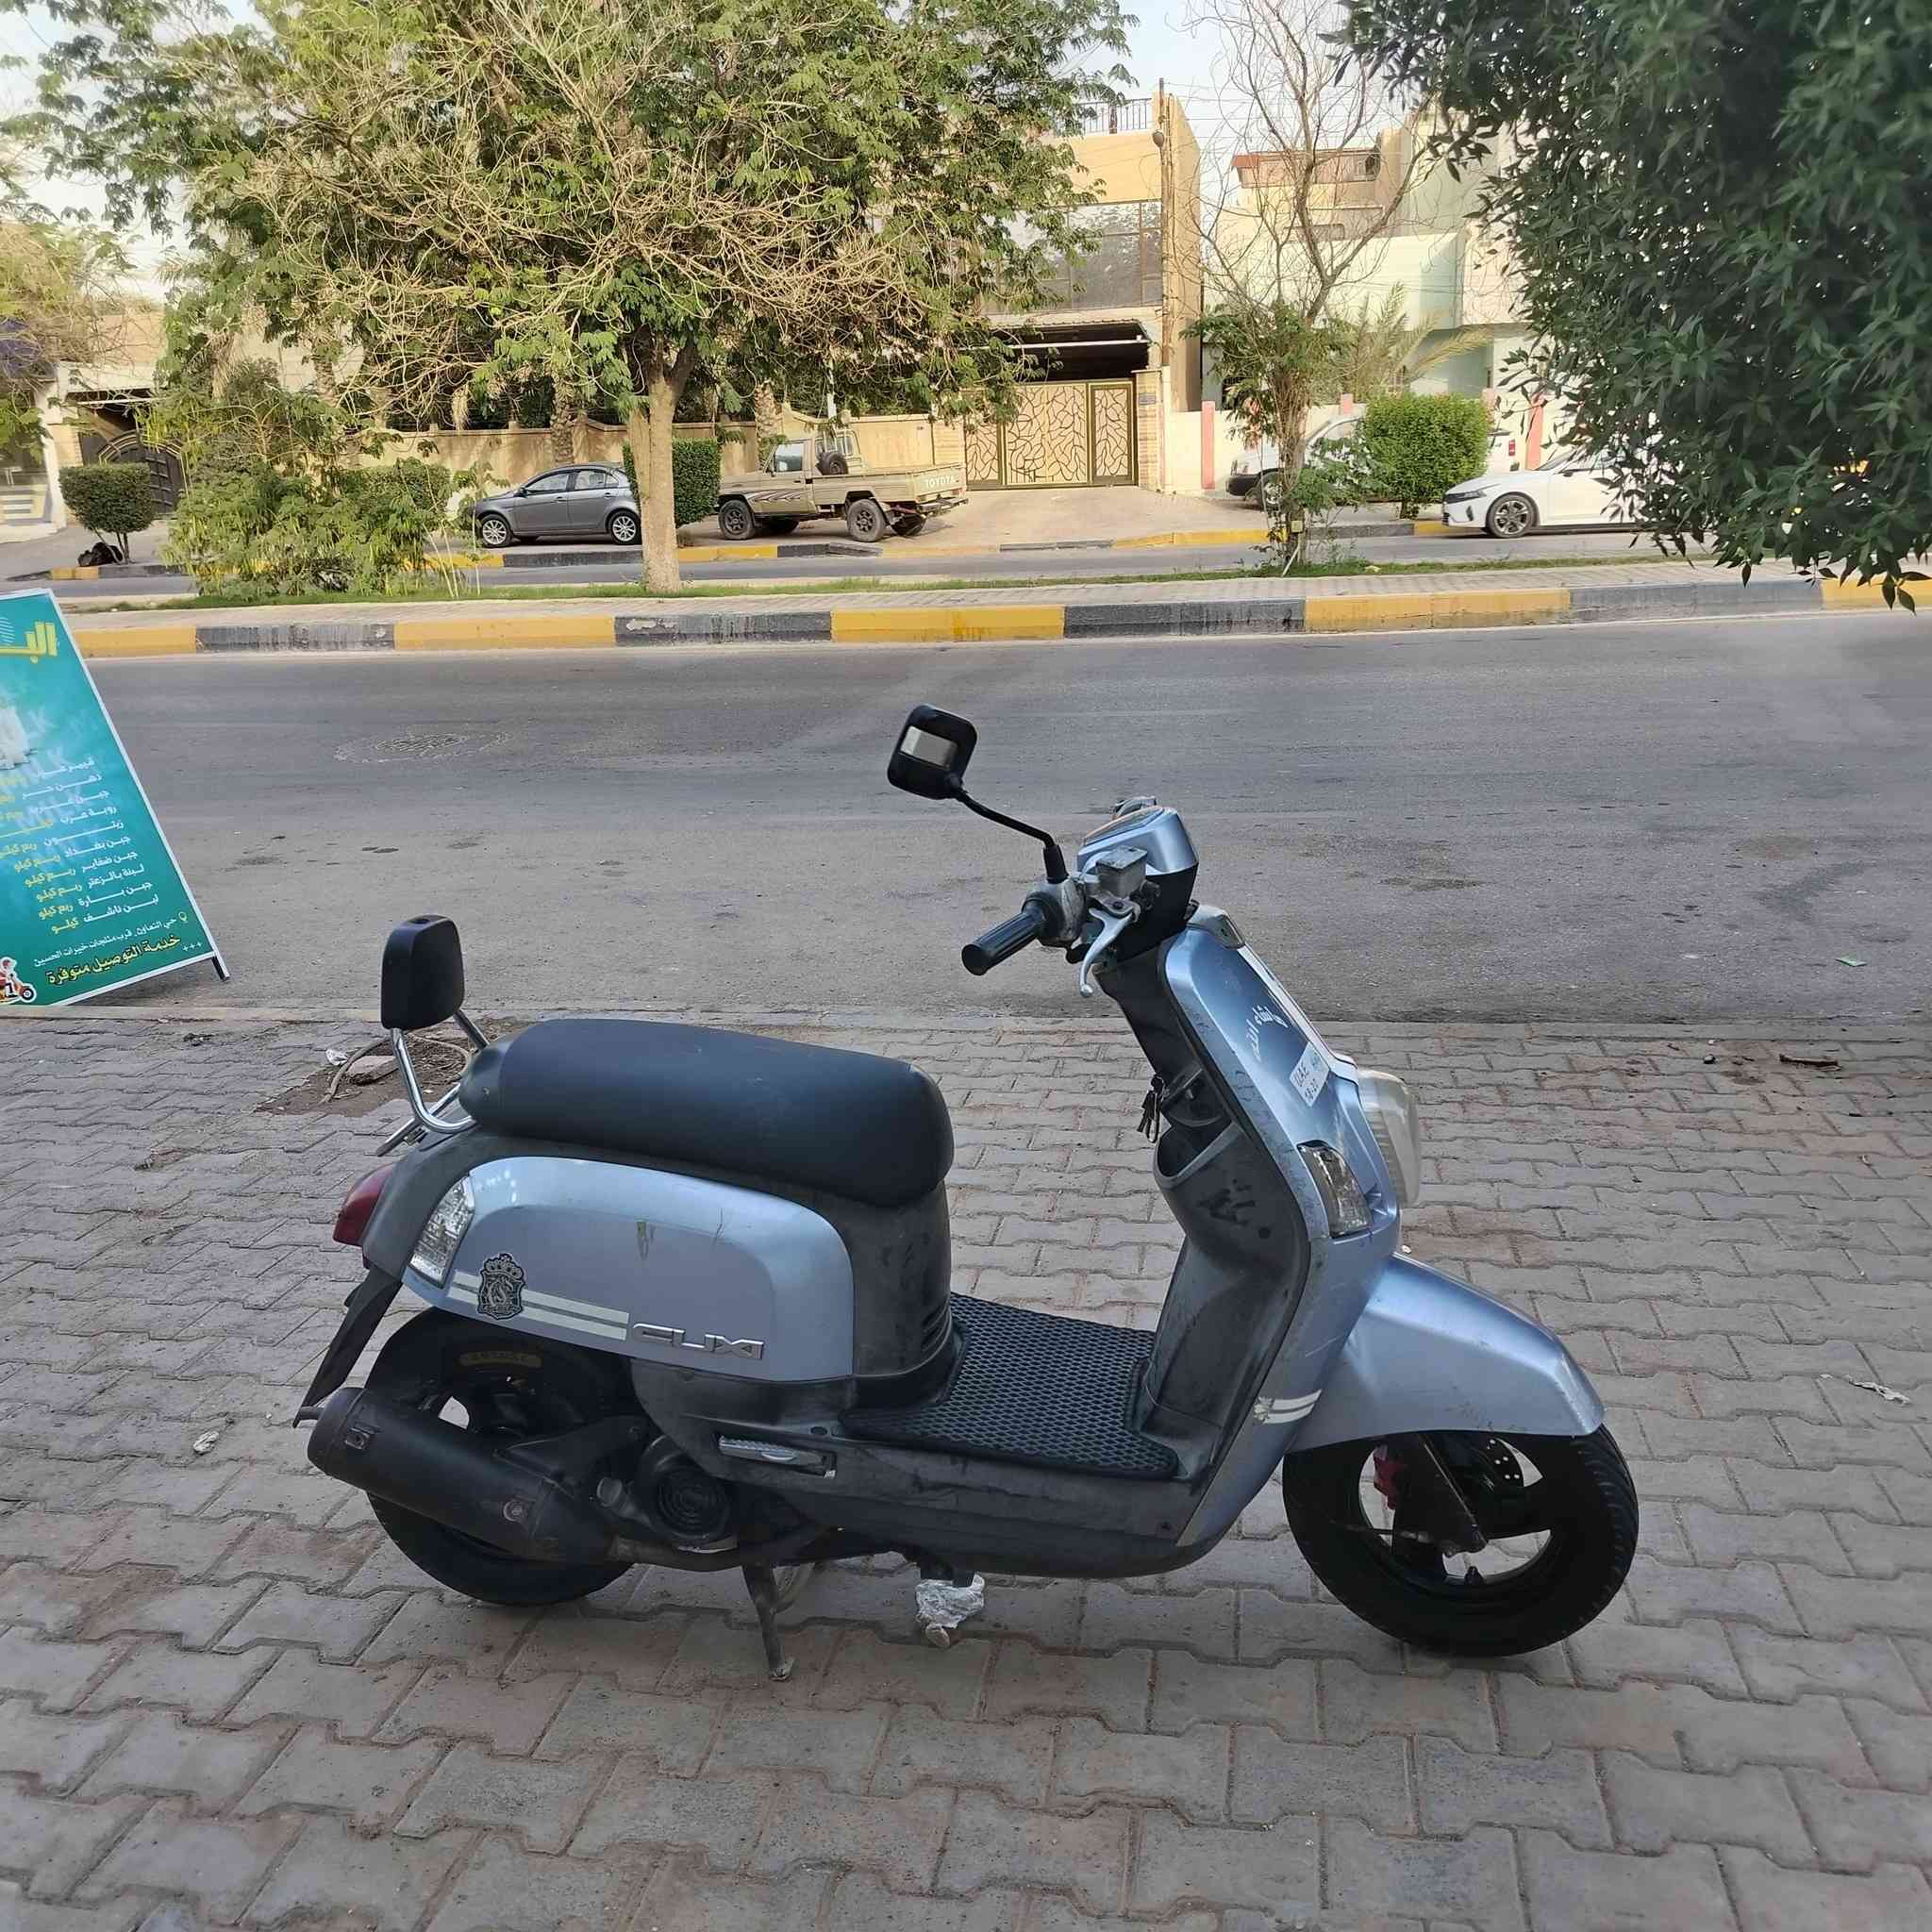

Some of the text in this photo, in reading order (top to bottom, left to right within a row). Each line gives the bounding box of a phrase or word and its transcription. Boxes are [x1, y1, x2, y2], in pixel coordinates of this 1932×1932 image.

[46, 934, 181, 985] خدمة التوصيل متوفرة
